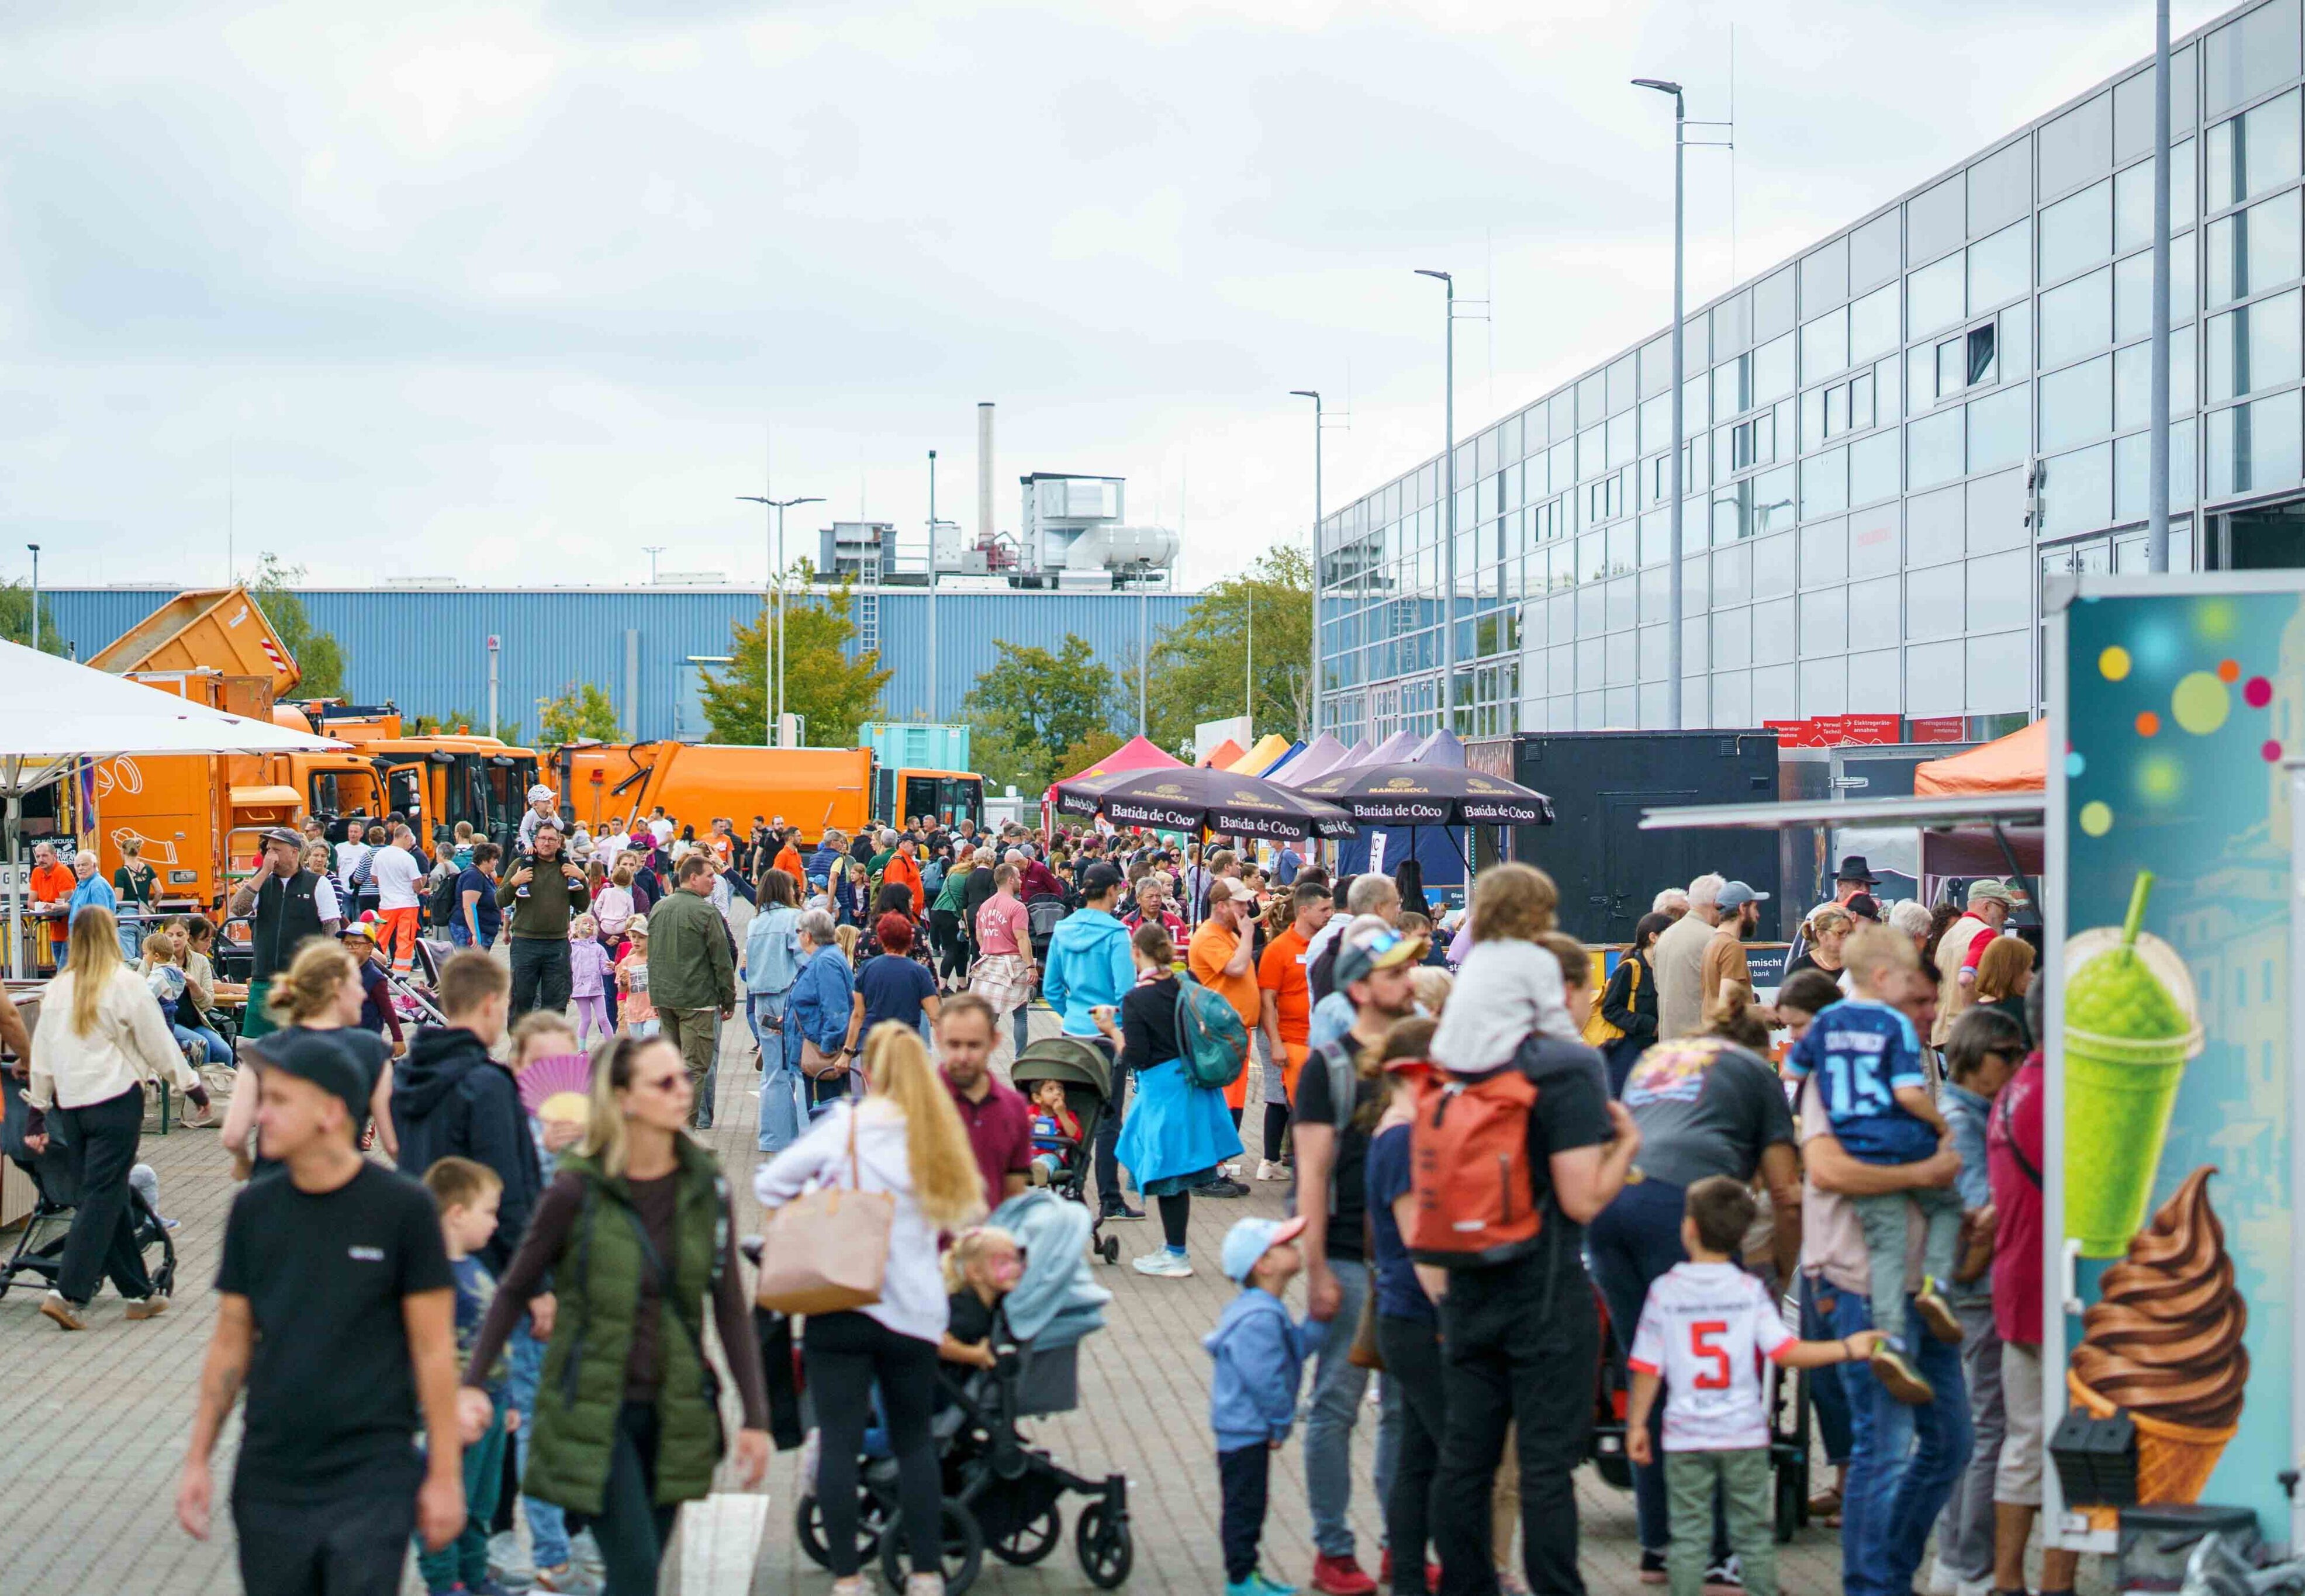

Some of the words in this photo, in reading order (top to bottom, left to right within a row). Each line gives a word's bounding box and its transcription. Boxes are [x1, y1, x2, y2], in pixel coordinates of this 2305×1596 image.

[1112, 804, 1148, 819] Batida
[1149, 808, 1164, 822] de
[1166, 811, 1195, 826] Côco
[1354, 804, 1392, 817] Batida
[1395, 804, 1409, 816] de
[1411, 804, 1442, 817] Côco
[1464, 805, 1497, 818] Batida
[1498, 805, 1508, 817] de
[1509, 806, 1535, 819] Côco
[1220, 816, 1255, 830] Batida
[1257, 819, 1269, 832] de
[1270, 821, 1300, 837] Côco
[1746, 958, 1782, 967] emischt
[1824, 1054, 1892, 1117] 15
[1690, 1320, 1730, 1389] 5
